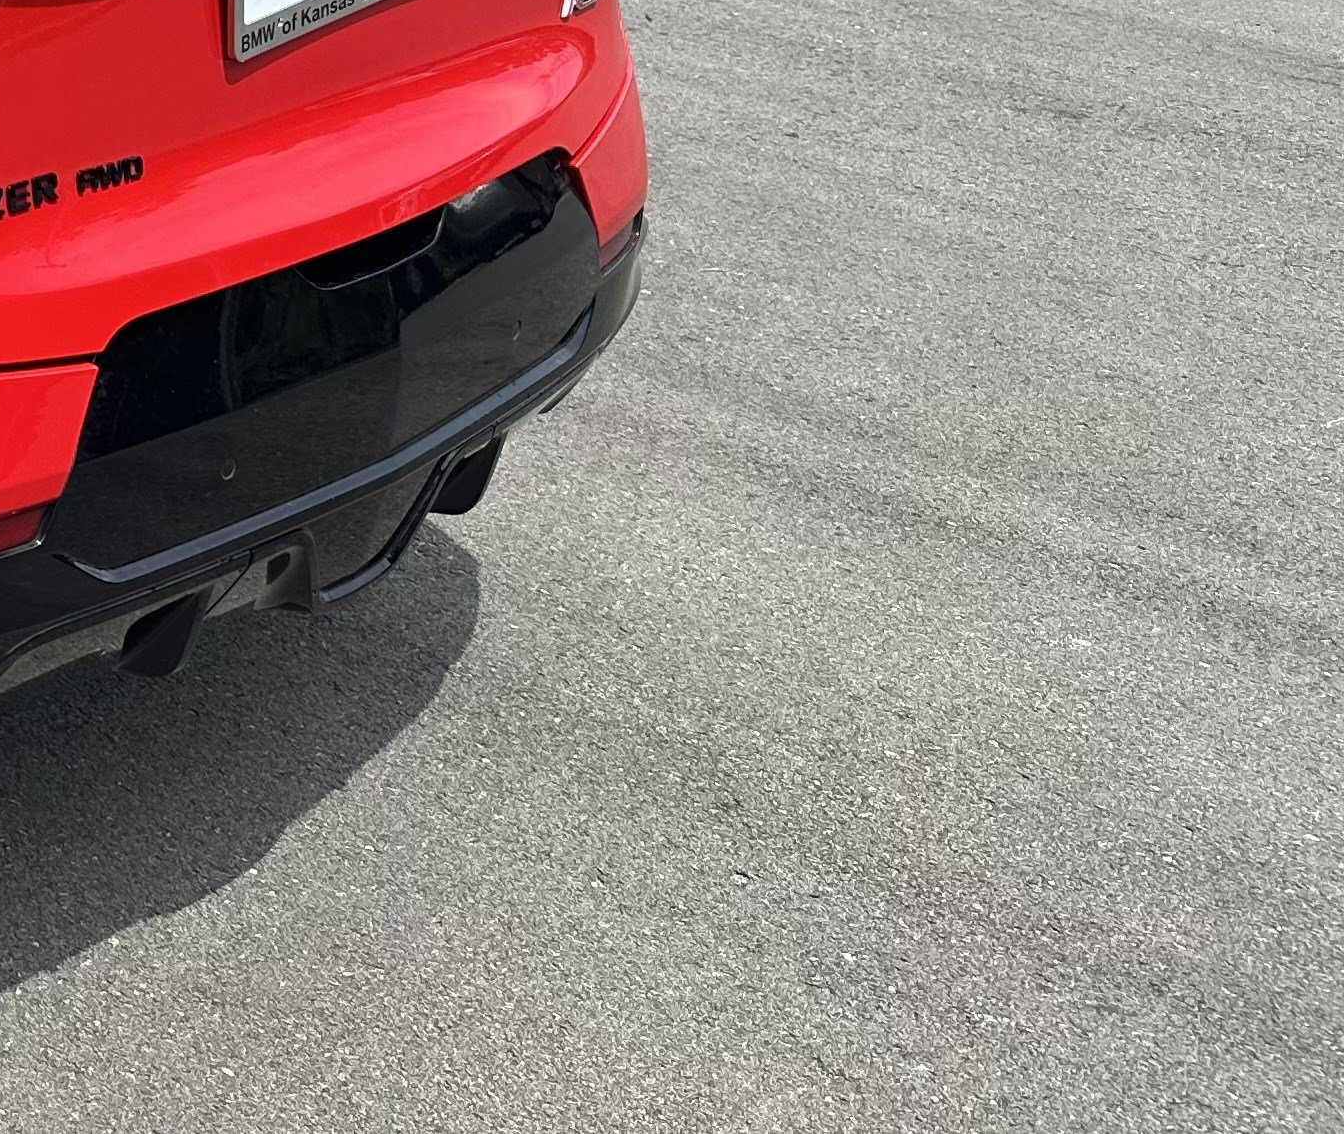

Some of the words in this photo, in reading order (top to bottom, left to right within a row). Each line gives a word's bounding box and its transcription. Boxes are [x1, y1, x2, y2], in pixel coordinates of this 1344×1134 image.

[241, 21, 277, 54] BMW
[282, 14, 297, 35] of
[75, 155, 144, 197] AWD
